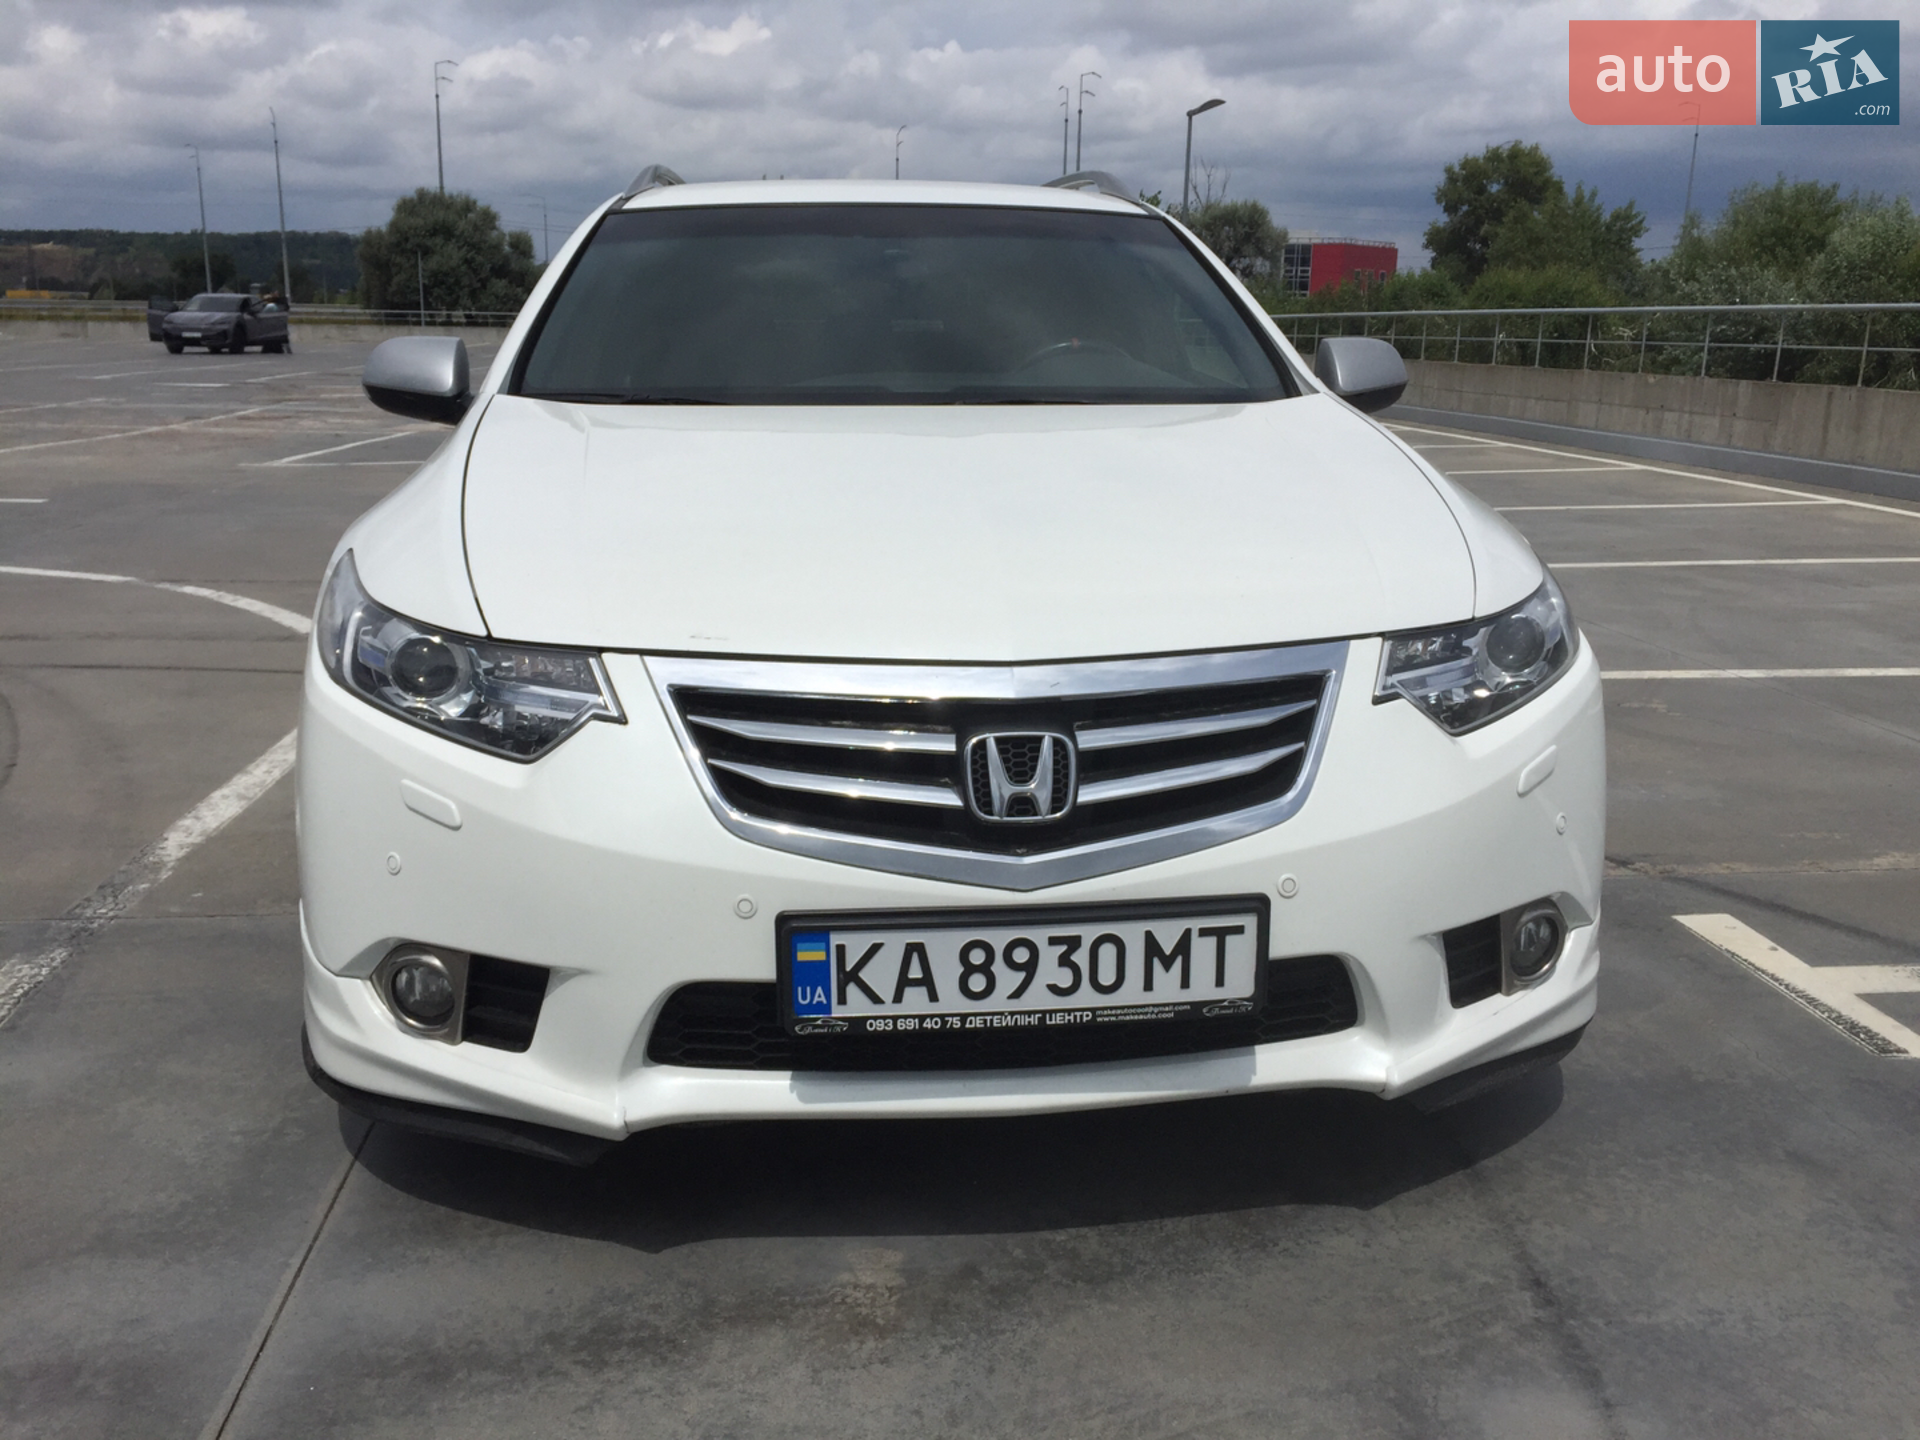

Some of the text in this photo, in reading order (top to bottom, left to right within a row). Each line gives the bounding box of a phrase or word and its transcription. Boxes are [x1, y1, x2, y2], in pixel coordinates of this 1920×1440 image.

[835, 924, 1246, 1006] KA 8930 MT
[797, 986, 827, 1005] UA
[866, 1011, 1093, 1031] 093 691 40 75 ДЕТЕЙЛІНГ ЦЕНТР
